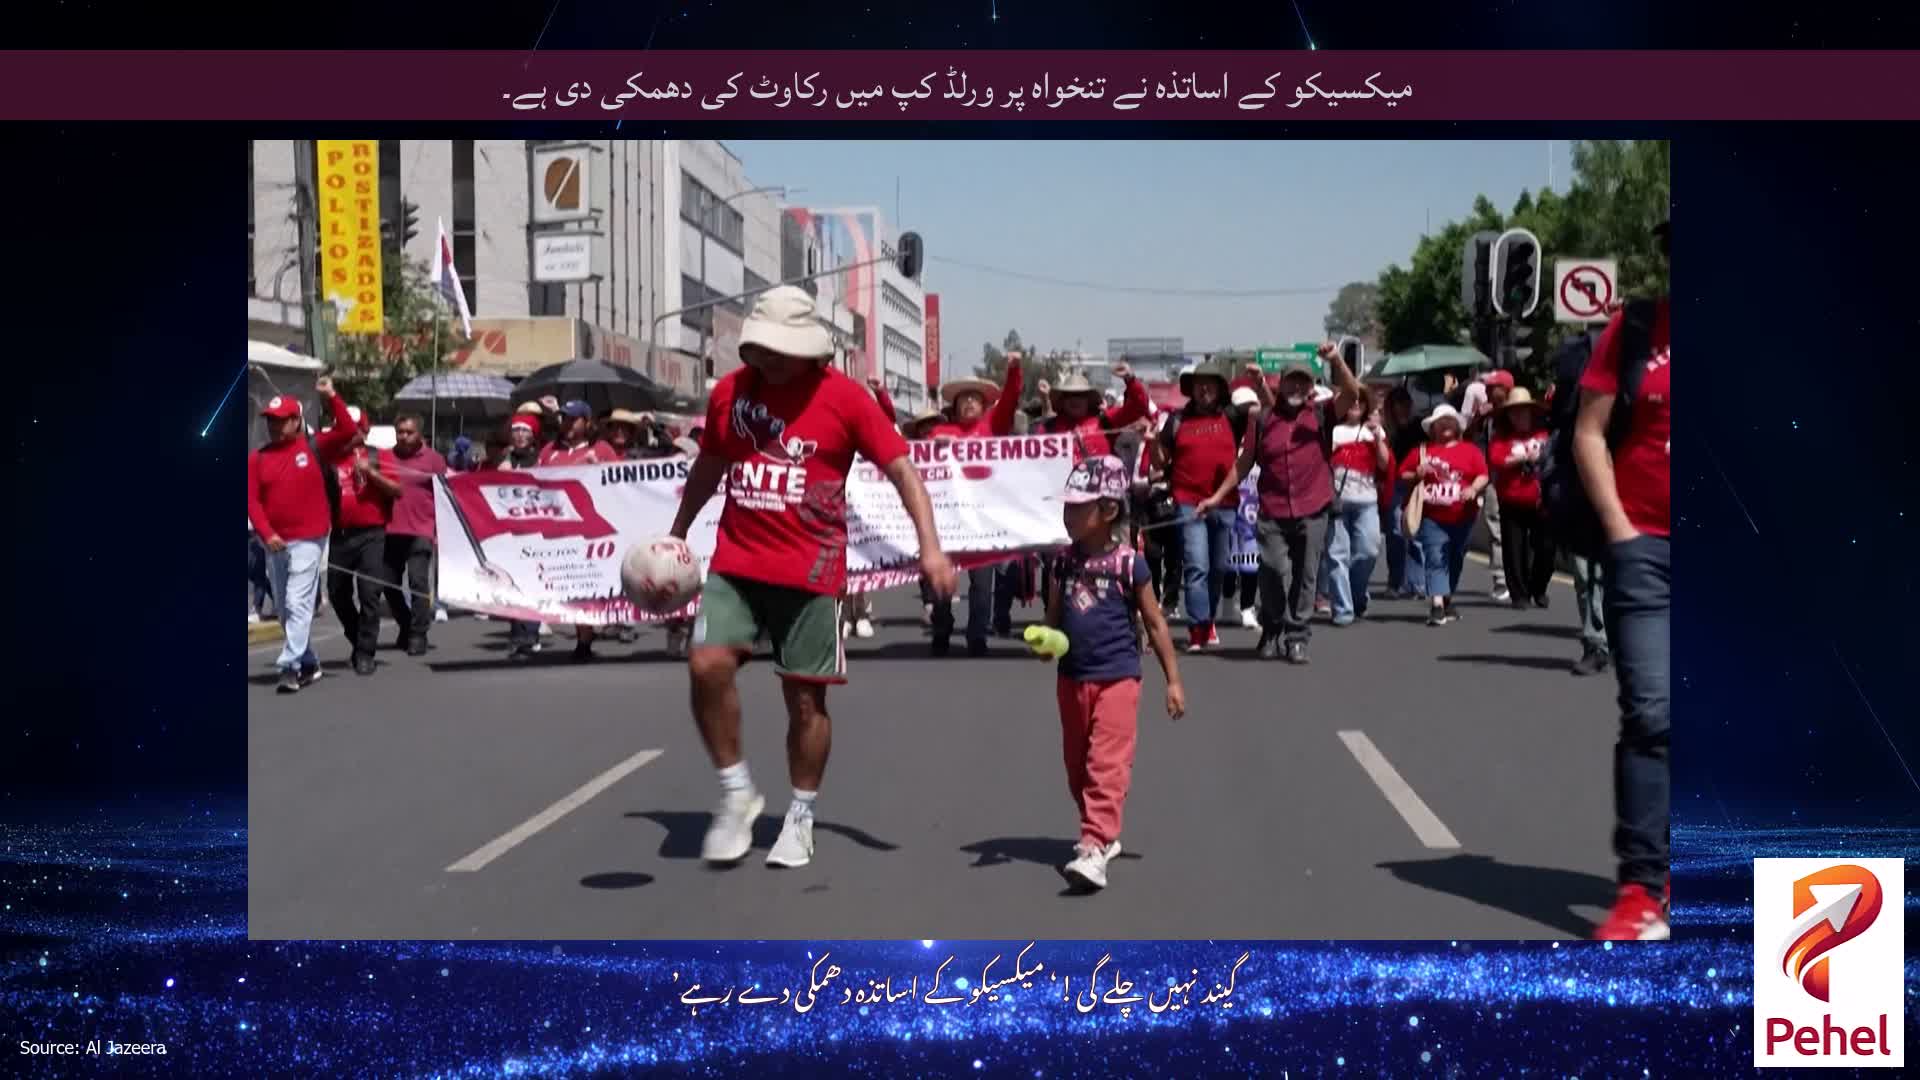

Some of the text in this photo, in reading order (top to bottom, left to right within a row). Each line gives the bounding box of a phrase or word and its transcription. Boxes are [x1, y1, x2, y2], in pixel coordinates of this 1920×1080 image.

[326, 150, 349, 284] POLLOS
[352, 142, 376, 322] ROSTIZADOS
[601, 461, 689, 487] ¡UNIDOS
[730, 461, 808, 496] CNTE
[585, 540, 616, 560] 10
